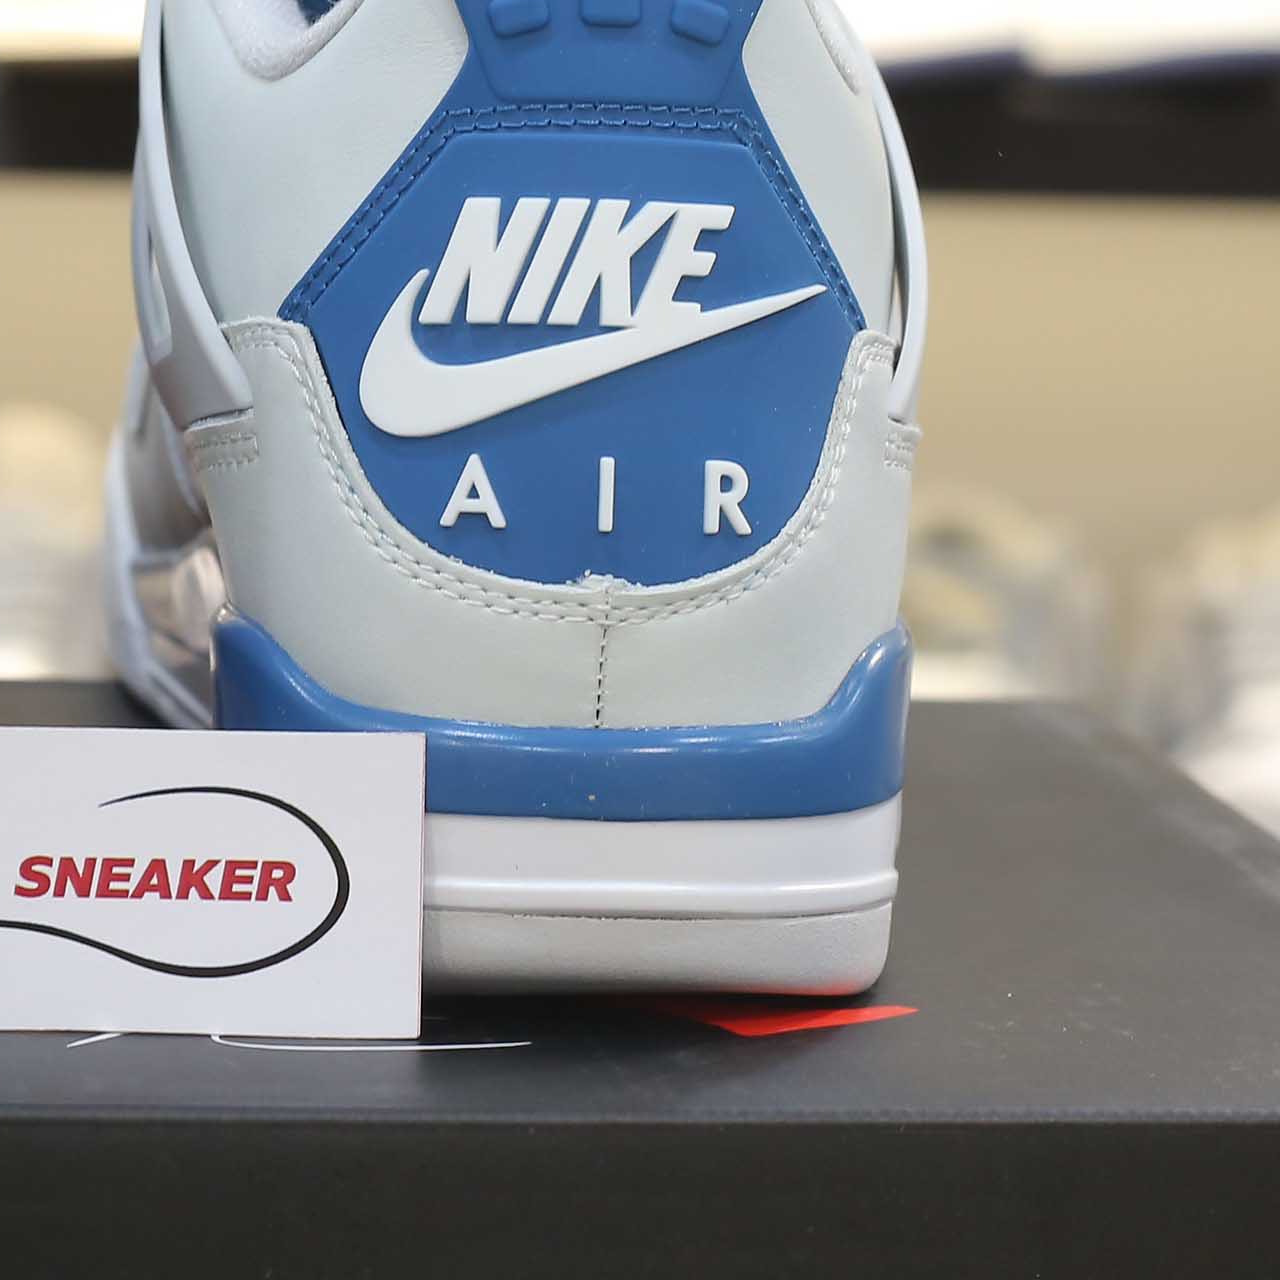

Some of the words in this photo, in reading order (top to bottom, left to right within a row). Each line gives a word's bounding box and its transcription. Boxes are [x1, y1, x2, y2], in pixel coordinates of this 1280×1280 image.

[419, 197, 735, 327] NIKE
[439, 453, 752, 536] AIR
[13, 855, 297, 903] SNEAKER
